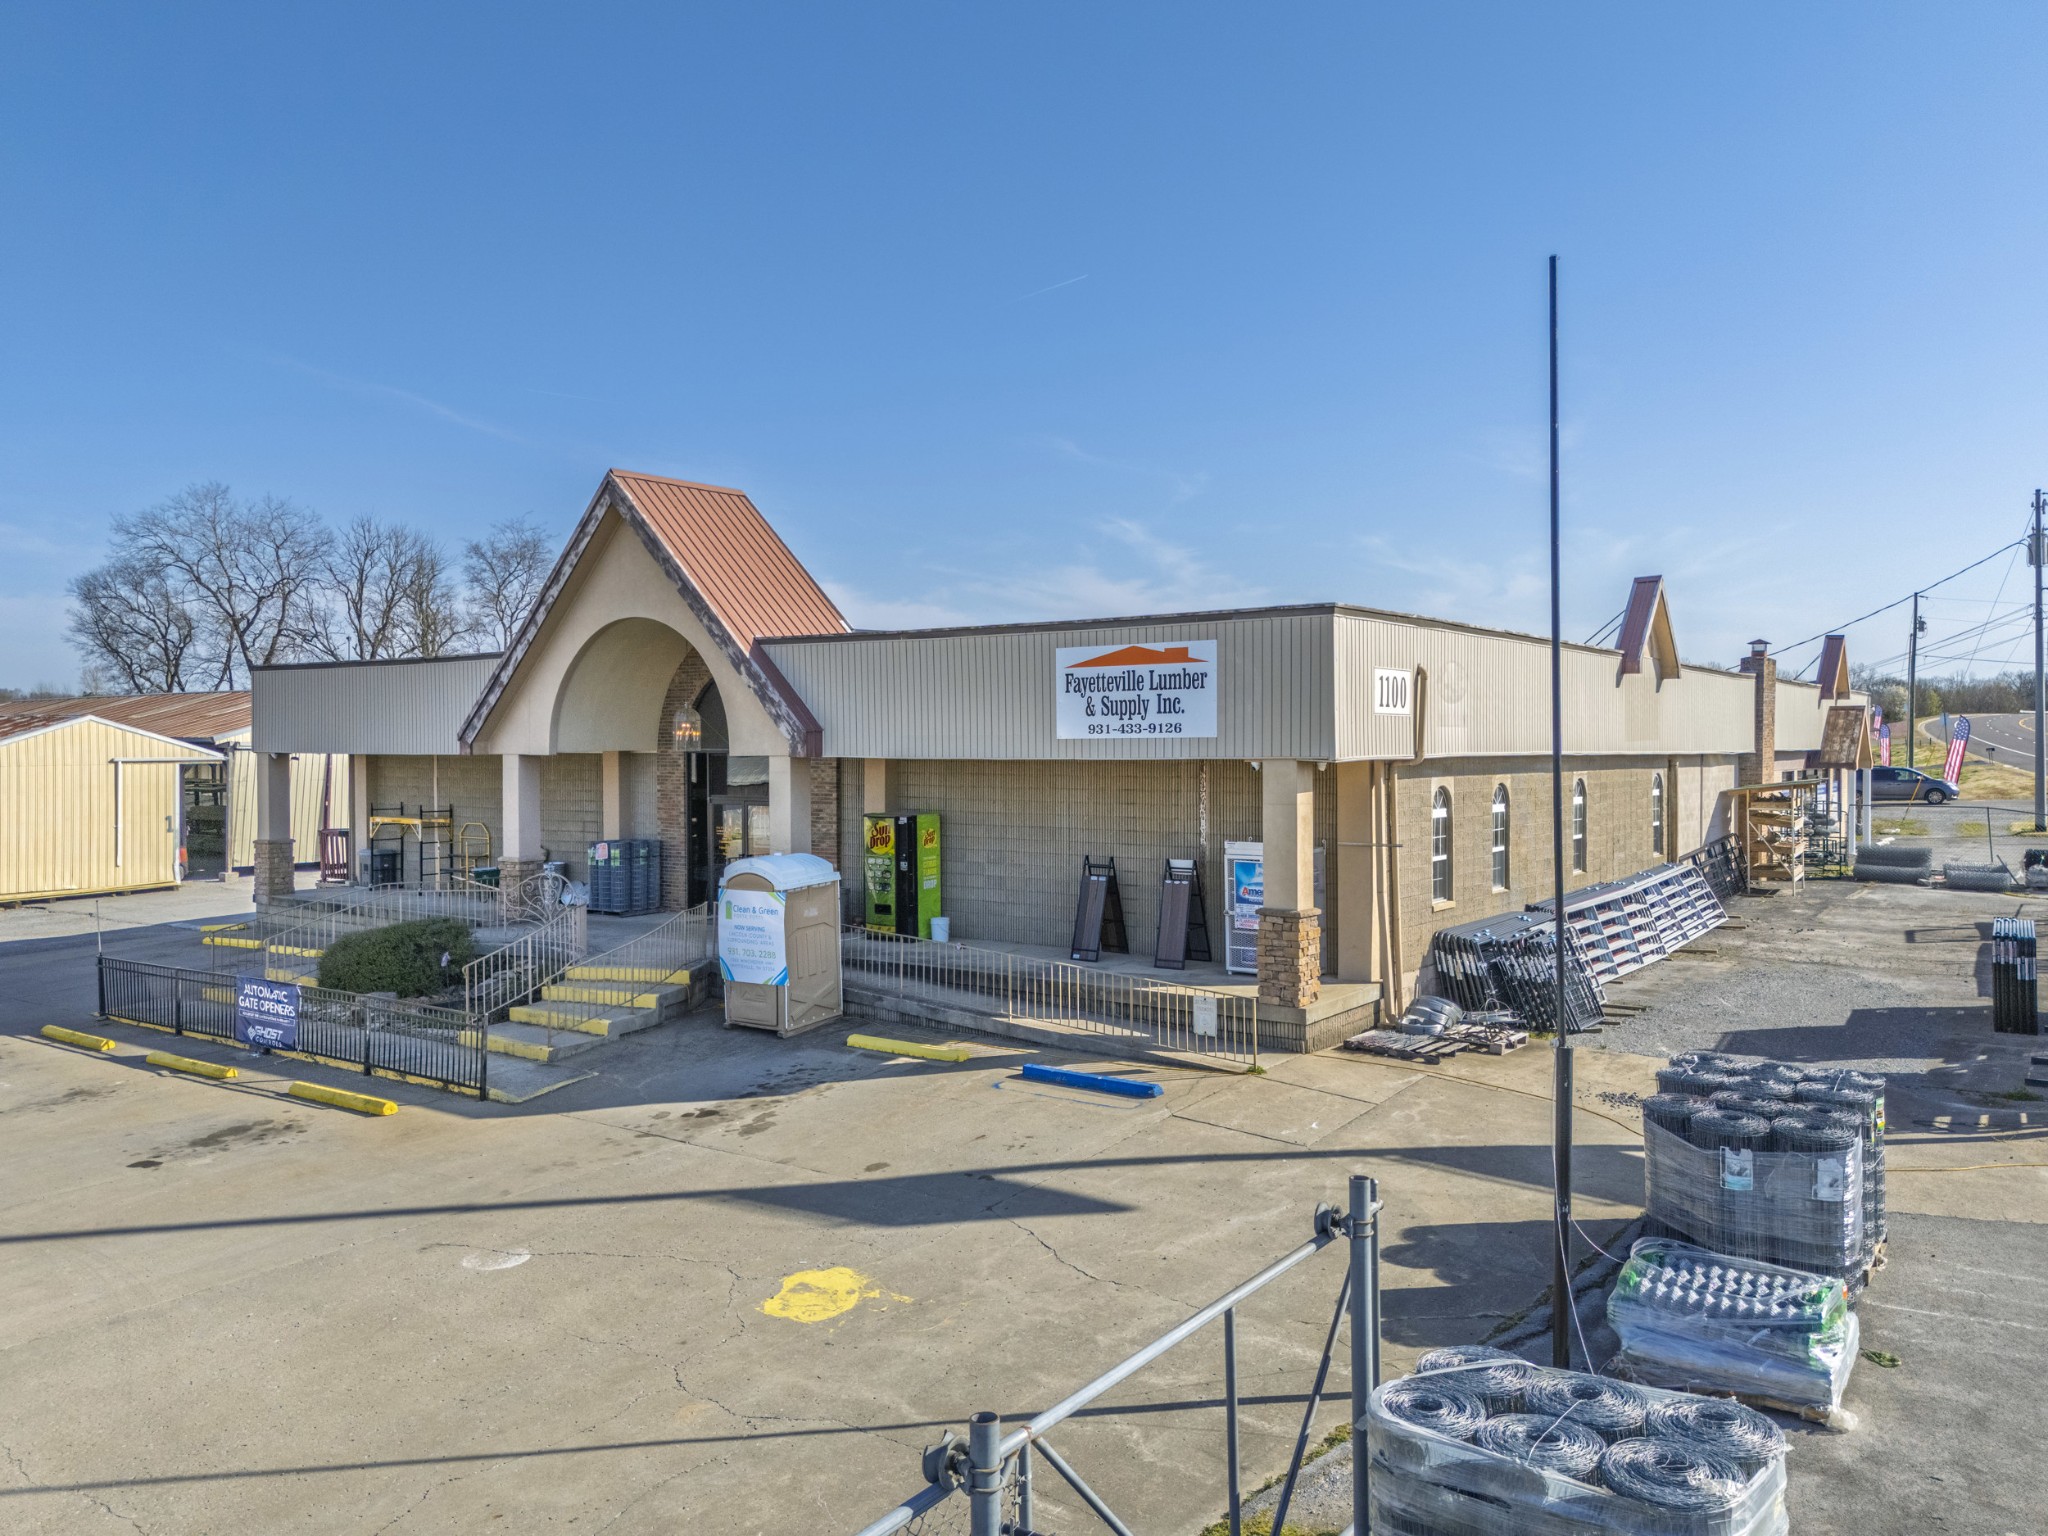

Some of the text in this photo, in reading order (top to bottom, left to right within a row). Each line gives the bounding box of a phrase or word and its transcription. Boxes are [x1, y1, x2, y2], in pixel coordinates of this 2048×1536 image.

[1065, 668, 1207, 698] Fayetteville Lumber
[1379, 675, 1407, 709] 1100
[1085, 693, 1185, 721] & Supply Inc.
[1088, 722, 1182, 735] 931-433-9126
[871, 822, 891, 837] Sun
[870, 834, 891, 849] Drop
[1242, 886, 1263, 898] Ame
[733, 905, 750, 913] Clean
[759, 907, 778, 915] Green
[244, 984, 288, 1002] AUTOMATIC
[239, 996, 295, 1016] GATE OPENERS
[255, 1026, 283, 1041] GHOST
[255, 1036, 282, 1047] CONROLS
